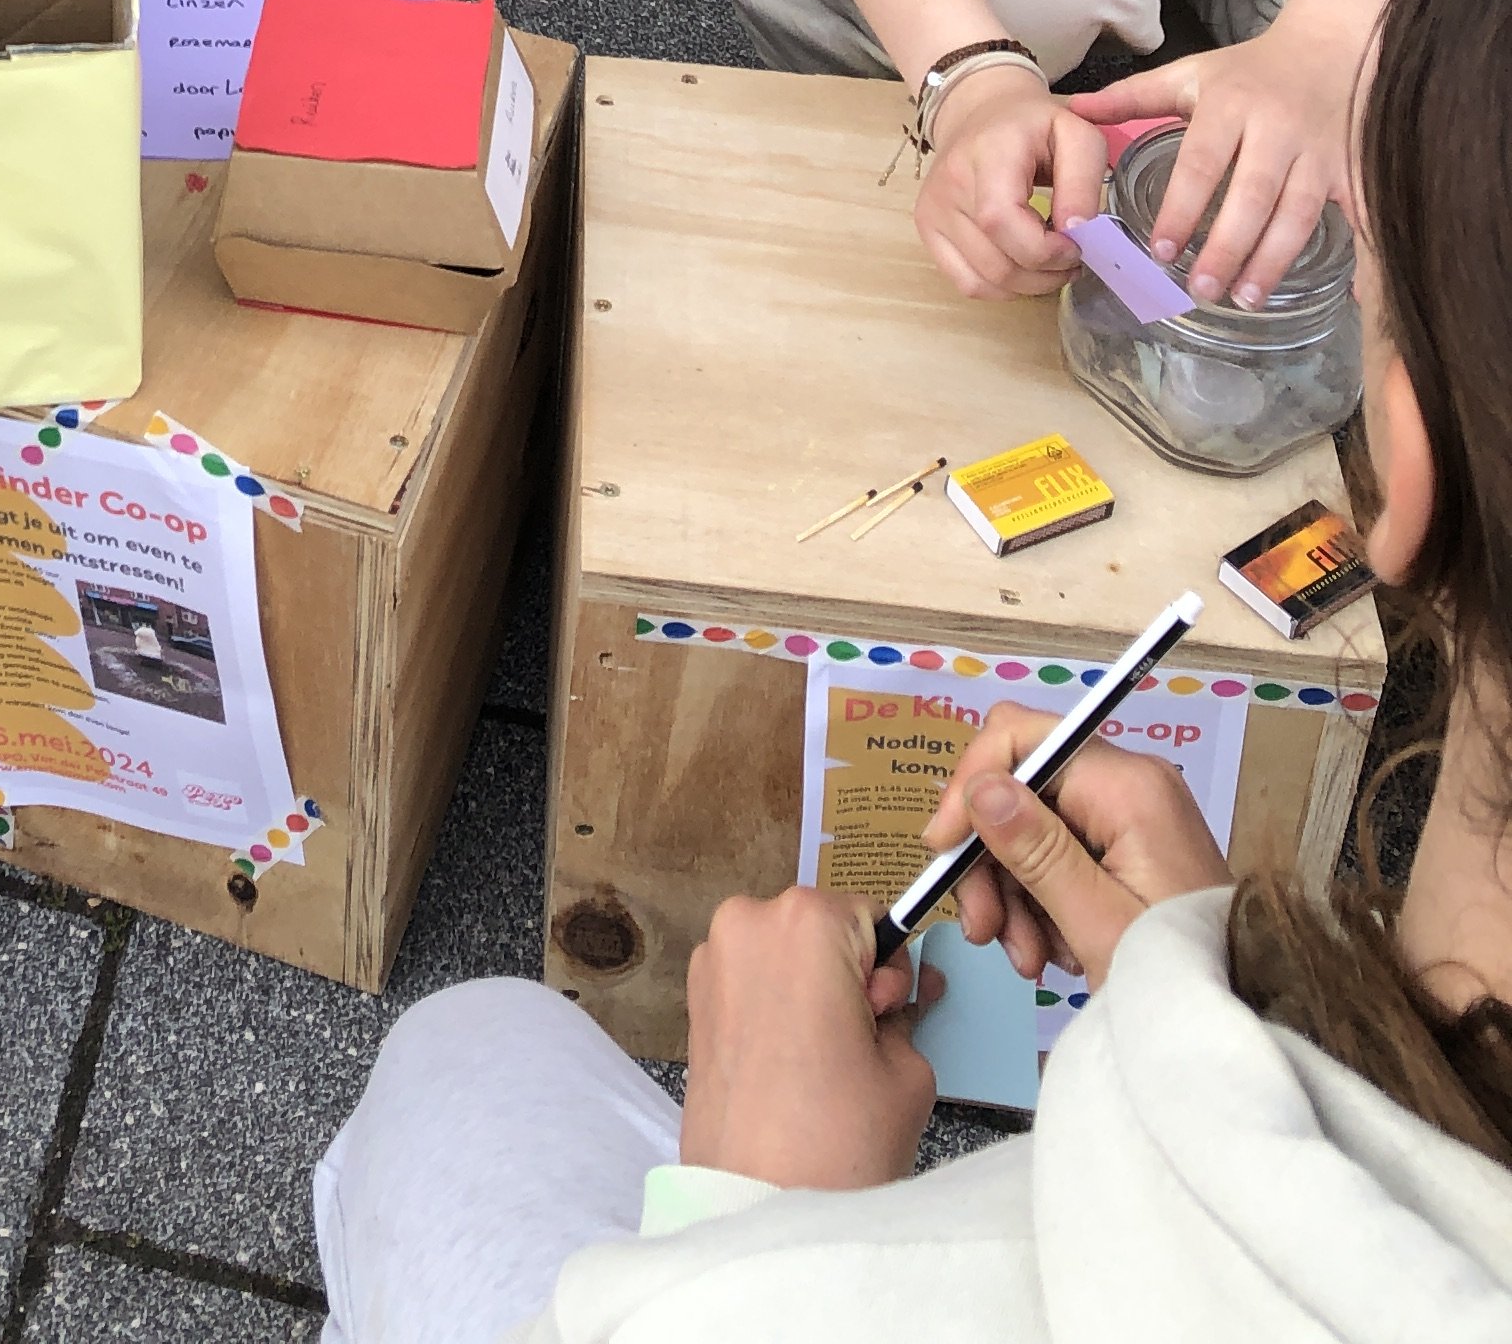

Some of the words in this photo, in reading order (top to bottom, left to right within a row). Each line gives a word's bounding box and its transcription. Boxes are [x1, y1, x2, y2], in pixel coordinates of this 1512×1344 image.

[1034, 464, 1097, 500] FLIX
[99, 490, 208, 545] Co-op
[24, 512, 43, 530] je
[48, 521, 79, 541] uit
[83, 532, 119, 549] om
[125, 538, 177, 565] even
[180, 555, 204, 575] te
[51, 545, 185, 593] ontstressen!
[844, 697, 899, 722] De
[912, 695, 980, 726] Kin
[1099, 720, 1201, 747] o-op
[866, 734, 956, 754] Nodigt
